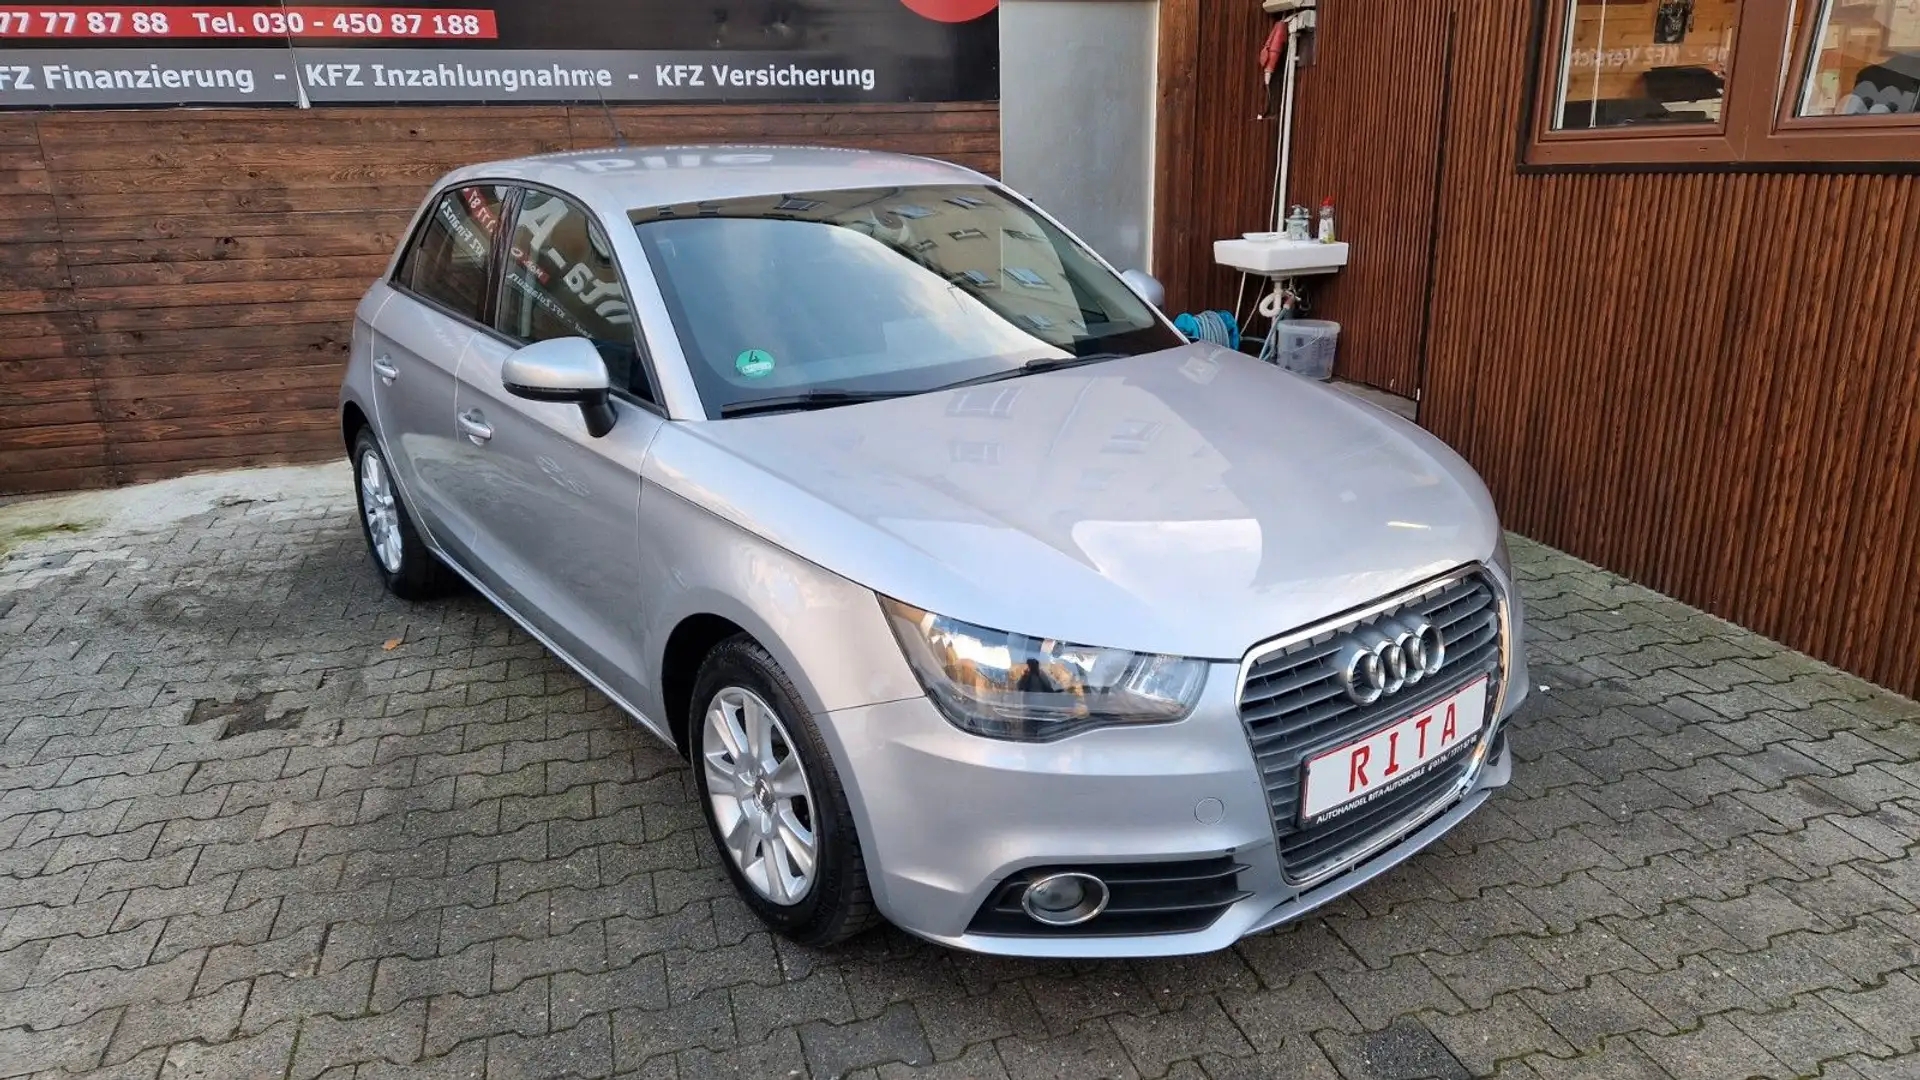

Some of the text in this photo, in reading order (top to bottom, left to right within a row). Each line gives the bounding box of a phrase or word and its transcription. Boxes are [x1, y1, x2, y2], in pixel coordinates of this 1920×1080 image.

[40, 12, 76, 33] 77
[86, 12, 121, 34] 87
[131, 12, 169, 34] 88
[192, 12, 244, 34] Tel.
[252, 13, 304, 33] 030
[332, 13, 382, 34] 450
[391, 14, 422, 34] 87
[432, 15, 480, 35] 188
[42, 64, 254, 93] Finanzierung
[305, 64, 363, 87] KFZ
[371, 63, 612, 92] Inzahlungnahme
[656, 65, 704, 87] KFZ
[711, 64, 875, 90] Versicherung
[1316, 795, 1369, 825] AUTOHANDEL
